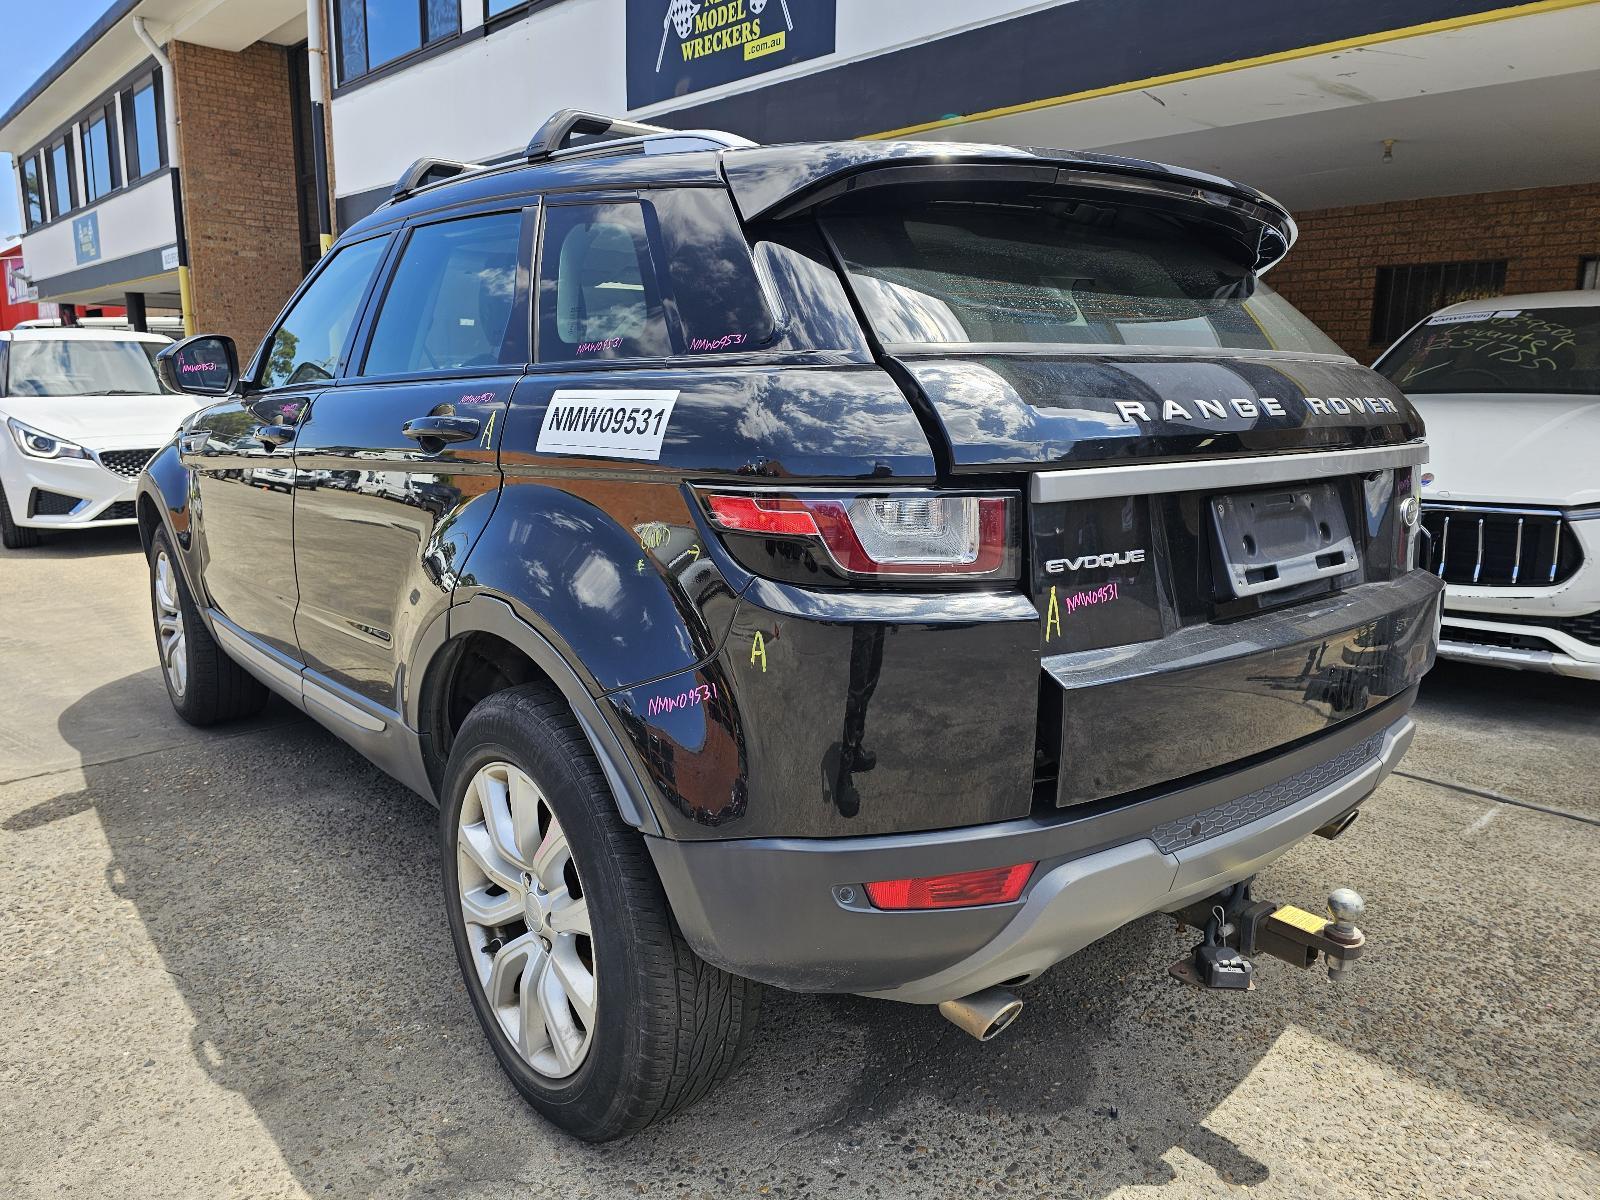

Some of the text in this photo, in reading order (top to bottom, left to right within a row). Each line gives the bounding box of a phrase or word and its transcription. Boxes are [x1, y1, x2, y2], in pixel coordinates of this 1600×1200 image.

[695, 0, 746, 35] MODEL
[681, 18, 761, 62] WRECKERS
[748, 38, 781, 54] .com.au
[690, 334, 747, 351] NMW09531
[548, 406, 667, 436] NMW09531
[1114, 397, 1398, 422] RANGE ROVER
[480, 409, 496, 450] A
[1045, 549, 1145, 574] EVOQUE
[1046, 585, 1061, 642] A
[1065, 582, 1119, 615] NMW09531
[751, 630, 767, 672] A
[648, 682, 718, 716] NMW09531
